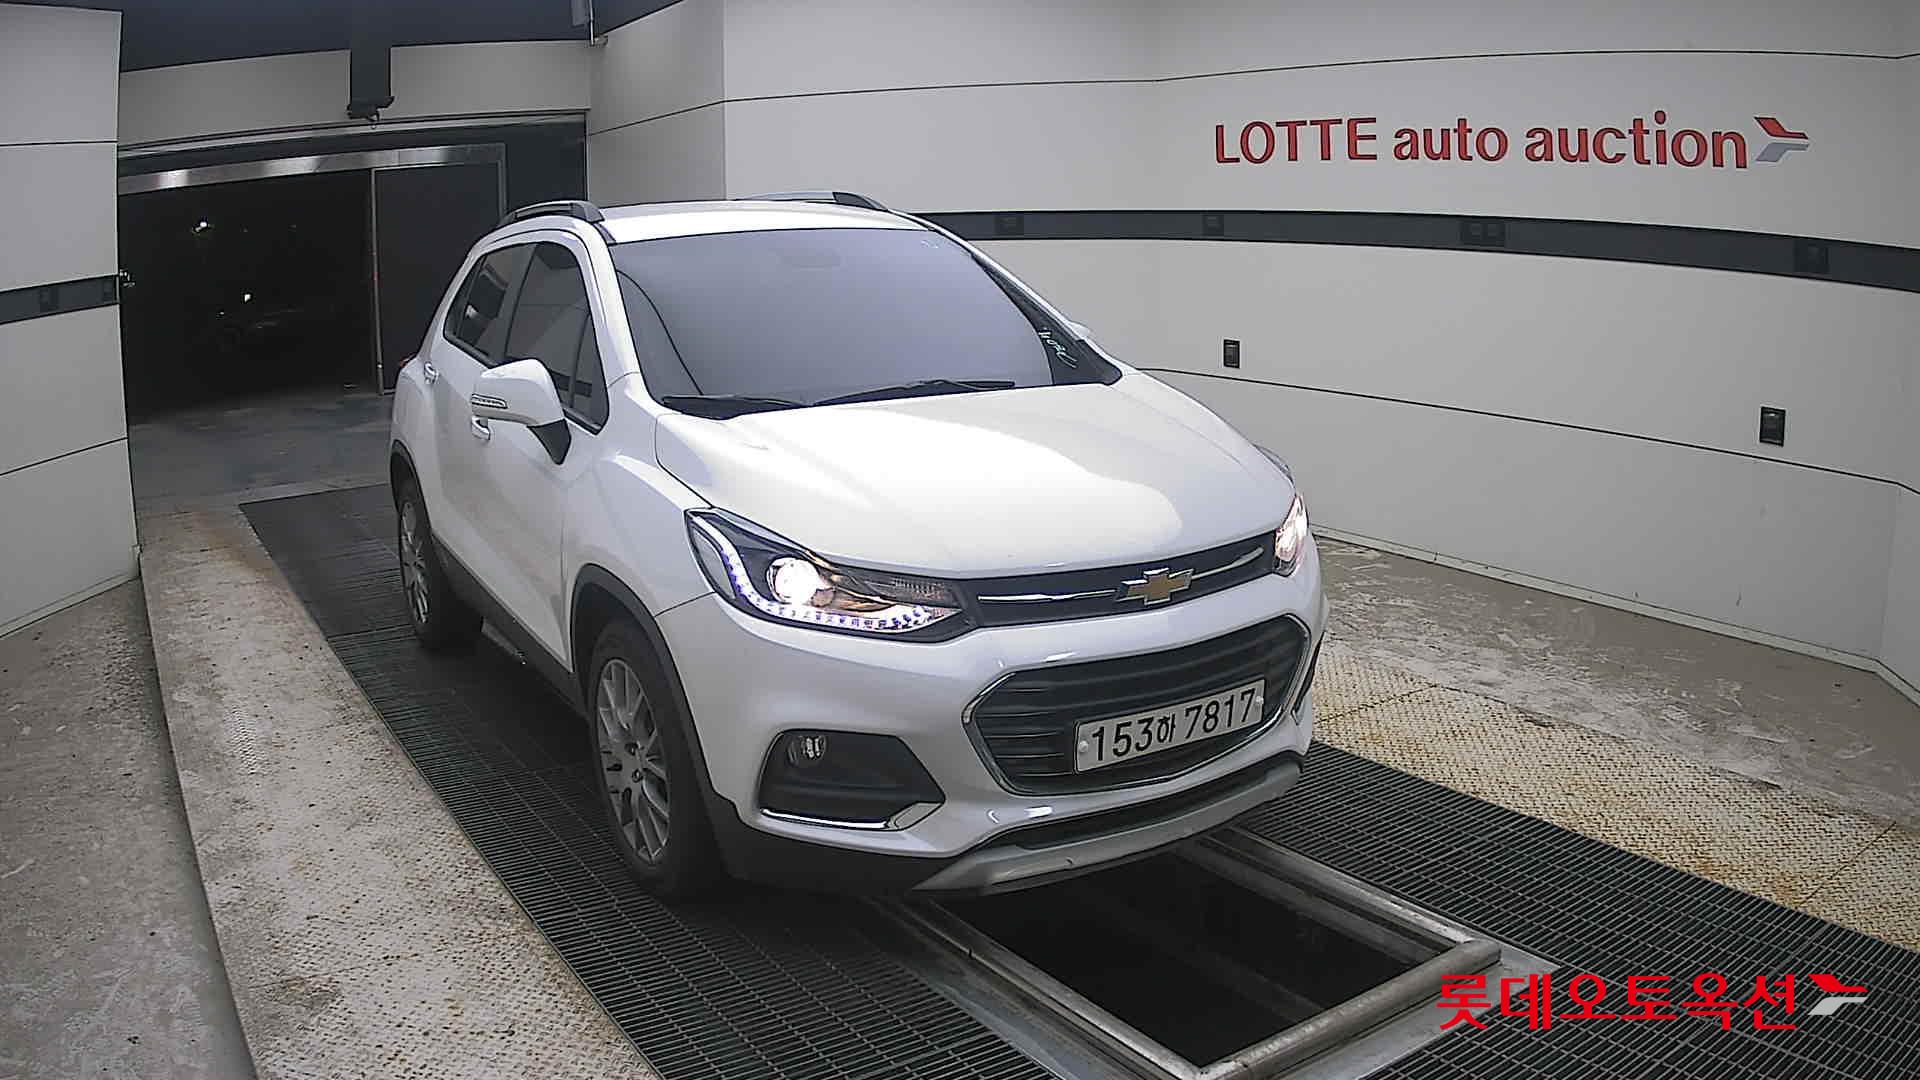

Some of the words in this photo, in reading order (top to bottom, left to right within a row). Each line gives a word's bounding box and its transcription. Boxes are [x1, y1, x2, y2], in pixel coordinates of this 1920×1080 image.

[1215, 117, 1377, 164] LOTTE
[1392, 118, 1509, 161] auto
[1524, 110, 1747, 169] auction
[1092, 714, 1176, 761] 153하
[1185, 688, 1256, 740] 7817
